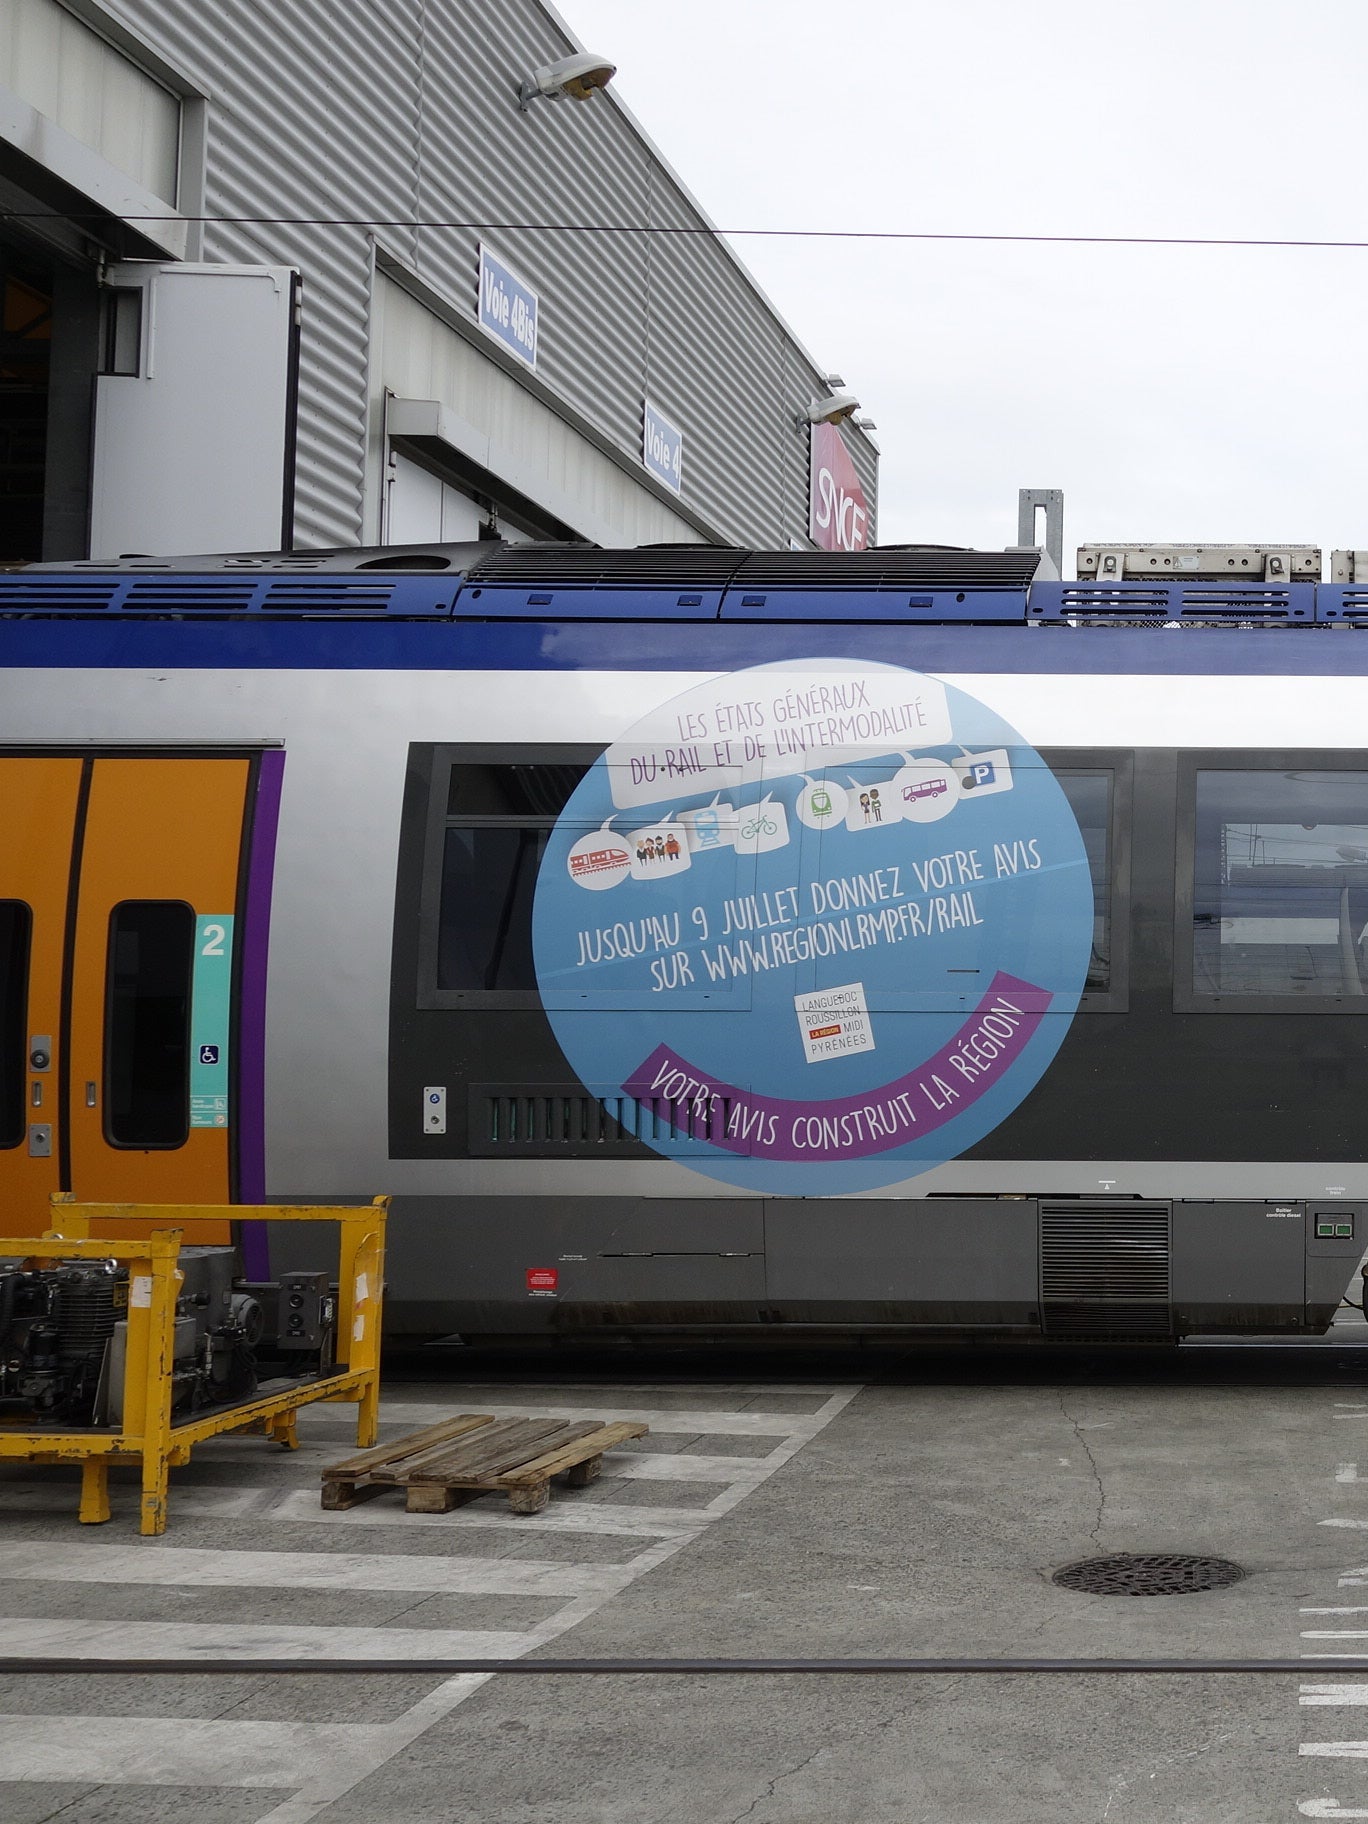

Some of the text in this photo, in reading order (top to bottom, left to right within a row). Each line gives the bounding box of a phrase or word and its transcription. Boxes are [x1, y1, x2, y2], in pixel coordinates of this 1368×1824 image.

[484, 267, 535, 351] Voie 4Bis
[647, 418, 680, 479] Voie 4
[815, 467, 866, 551] SNCF
[630, 696, 927, 785] DU RAIL ET DE L'INTERMODALITÉ
[677, 680, 871, 742] LES ÉTATS GÉNÉRAUX
[974, 765, 990, 784] P
[577, 838, 1042, 966] JUSQU'AU 9 JUILLET DONNEZ VOTRE AVIS
[202, 924, 225, 956] 2
[650, 891, 984, 992] SUR WWW.REGIONLRMP.FR/RAIL
[802, 992, 858, 1012] LANGUEDOC
[805, 1005, 861, 1026] ROUSSILLON
[843, 1019, 864, 1032] MIDI
[811, 1030, 820, 1038] LA
[811, 1033, 867, 1055] PYRÉNÉES
[650, 997, 1025, 1150] VOTRE AVIS CONSTRUIT LA RÉGION
